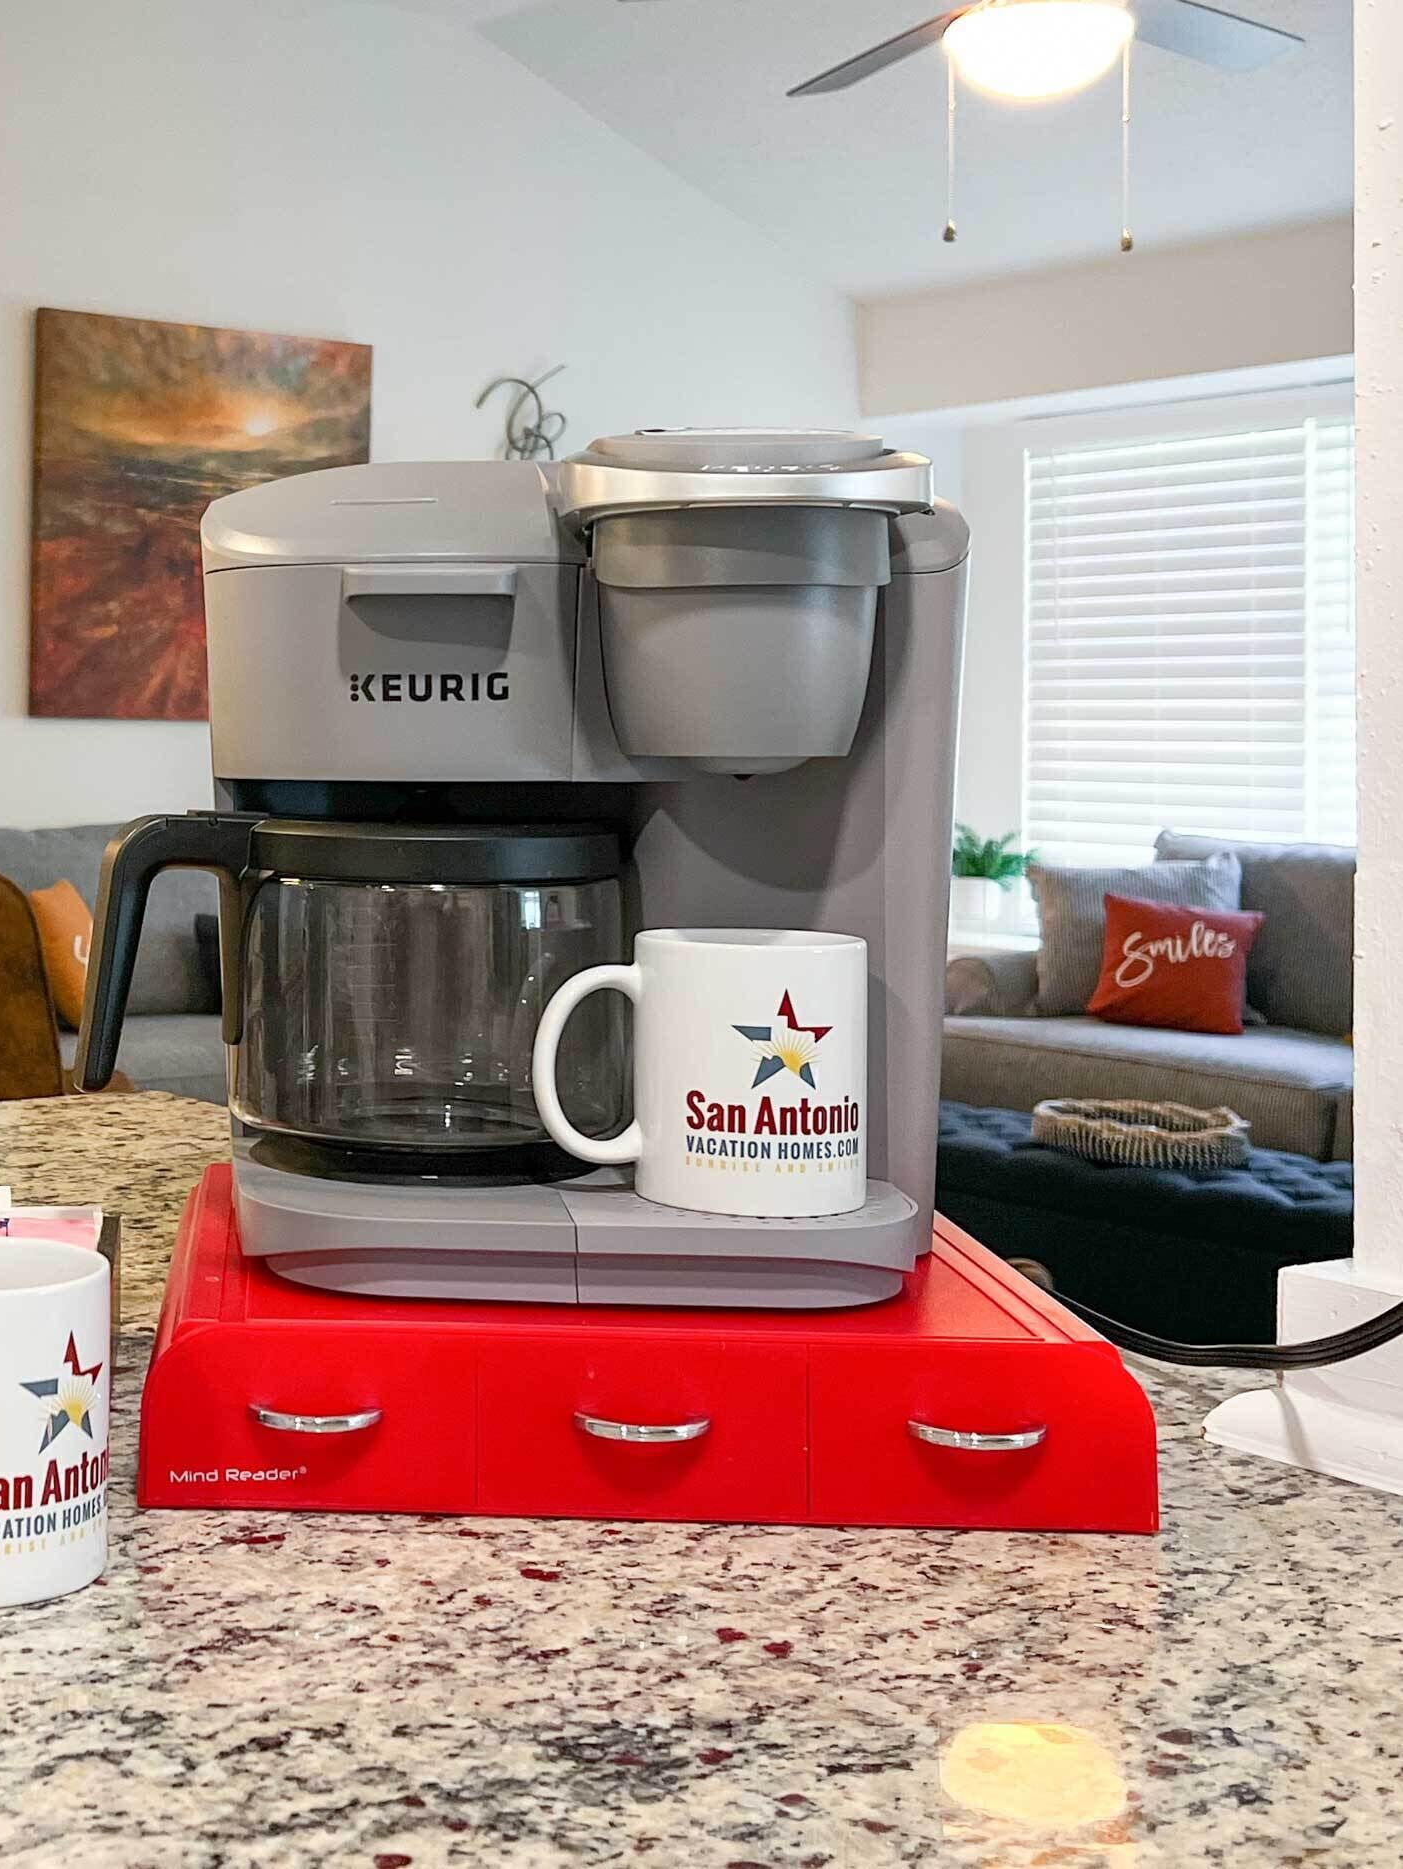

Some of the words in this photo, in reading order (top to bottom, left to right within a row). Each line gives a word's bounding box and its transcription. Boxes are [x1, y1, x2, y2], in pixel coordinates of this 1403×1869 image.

[350, 671, 509, 701] KEURIG
[1115, 921, 1236, 988] Smiles
[686, 1090, 747, 1134] San
[754, 1095, 859, 1135] Antonio
[686, 1135, 772, 1159] VACATION
[778, 1137, 859, 1159] HOMES.COM
[40, 1449, 109, 1507] Anton
[170, 1469, 219, 1483] Mind
